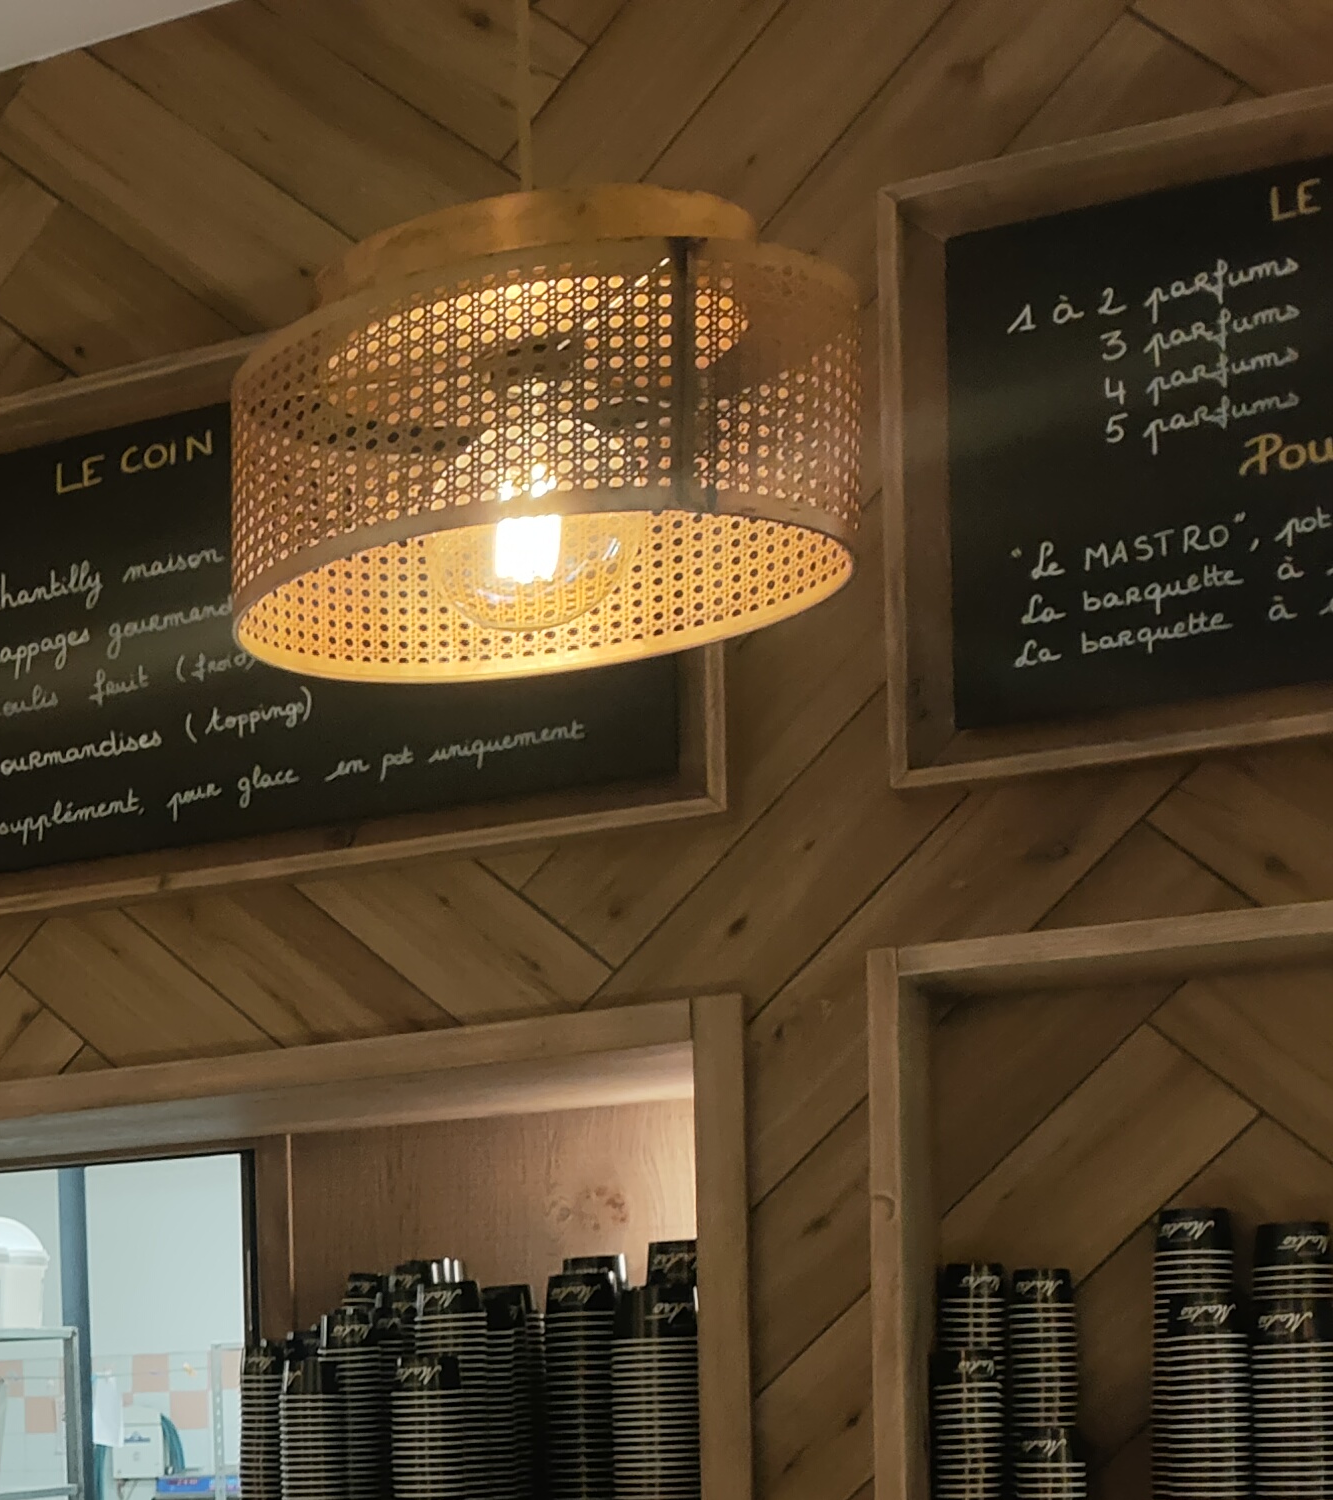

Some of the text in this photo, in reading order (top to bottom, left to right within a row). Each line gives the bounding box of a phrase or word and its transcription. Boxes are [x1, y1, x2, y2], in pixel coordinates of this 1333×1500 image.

[1269, 177, 1321, 222] LE
[1006, 258, 1300, 334] 1 à 2 parfums
[1100, 304, 1300, 367] 3 parfums
[1104, 347, 1299, 406] 4 parfums
[1105, 392, 1299, 455] 5 parfums
[56, 429, 212, 495] LE COIN
[122, 547, 225, 584] maison
[1021, 556, 1304, 624] La barquette à
[1013, 640, 1062, 668] La
[1081, 612, 1233, 654] barquette
[1268, 596, 1298, 622] à
[89, 666, 149, 706] fruit
[166, 782, 222, 822] pour
[237, 764, 300, 808] glace
[324, 759, 371, 782] en
[379, 745, 414, 782] pot
[428, 720, 587, 769] uniquement
